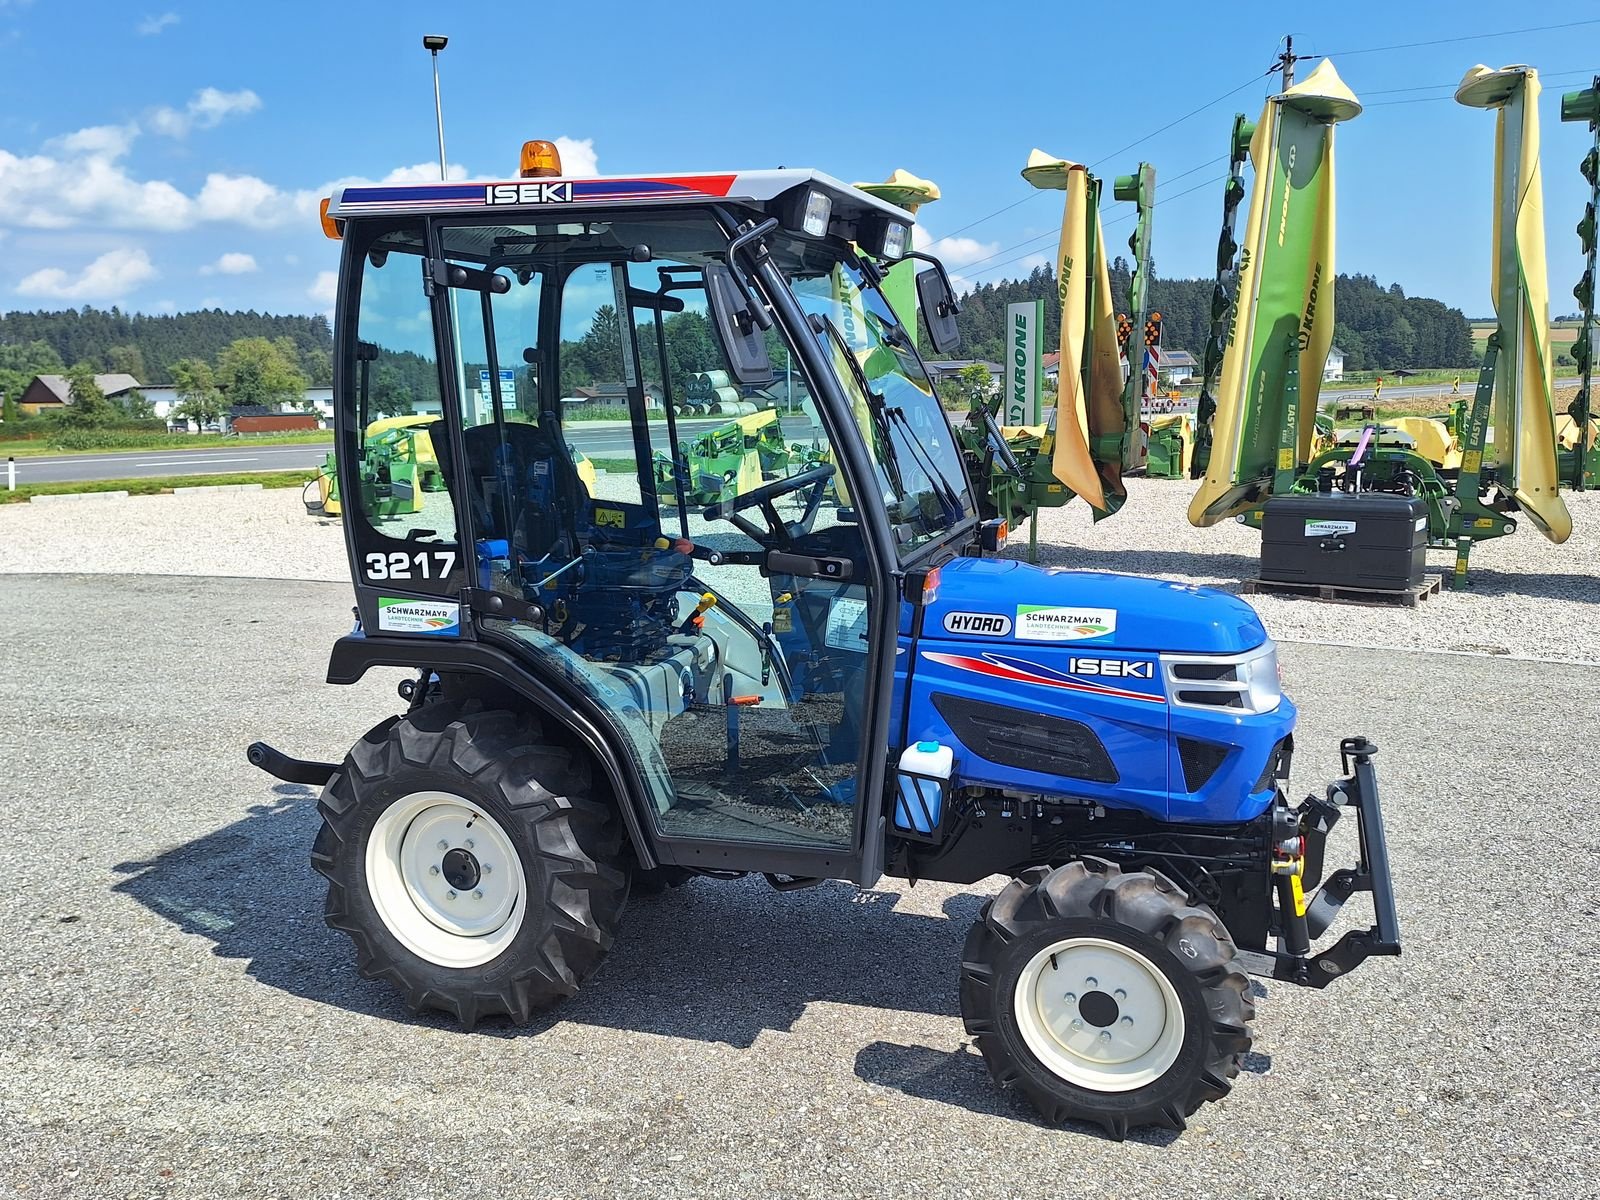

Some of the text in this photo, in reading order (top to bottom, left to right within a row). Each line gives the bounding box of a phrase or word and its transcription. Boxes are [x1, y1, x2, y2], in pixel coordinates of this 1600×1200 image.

[486, 182, 573, 204] ISEKI
[1060, 255, 1073, 317] ONE
[1303, 262, 1322, 332] KRONE
[840, 291, 857, 350] KRON
[1014, 313, 1027, 403] KRONE
[366, 552, 456, 579] 3217
[386, 606, 448, 617] SCHWARZMAYR
[388, 615, 423, 623] LANDTECHNIK
[1026, 613, 1102, 625] SCHWARZMAYR
[951, 615, 1004, 632] HYDRO
[1069, 657, 1154, 679] ISEKI
